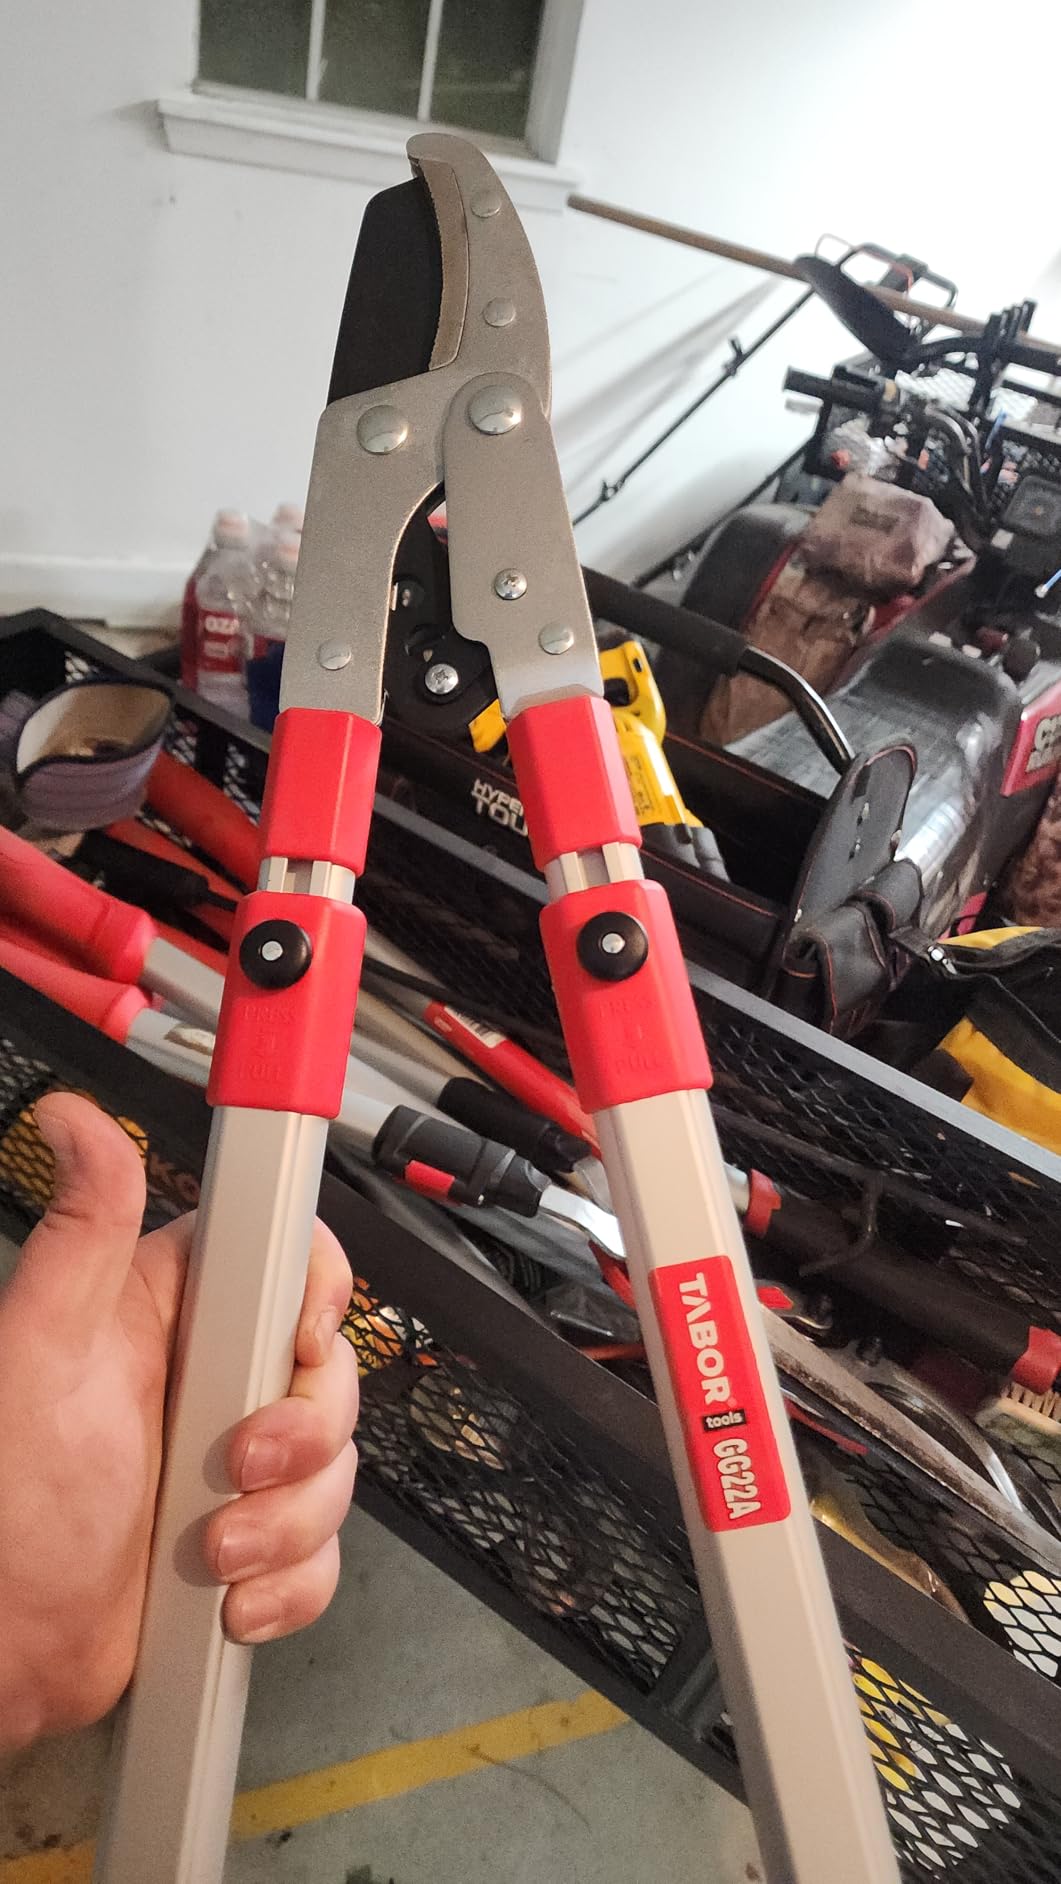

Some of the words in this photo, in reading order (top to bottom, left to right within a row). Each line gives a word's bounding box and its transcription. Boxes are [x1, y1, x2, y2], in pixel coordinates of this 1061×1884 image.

[473, 778, 524, 817] HYPE
[679, 1272, 732, 1406] TABOR
[705, 1410, 744, 1429] tools
[713, 1438, 762, 1521] GG22A
